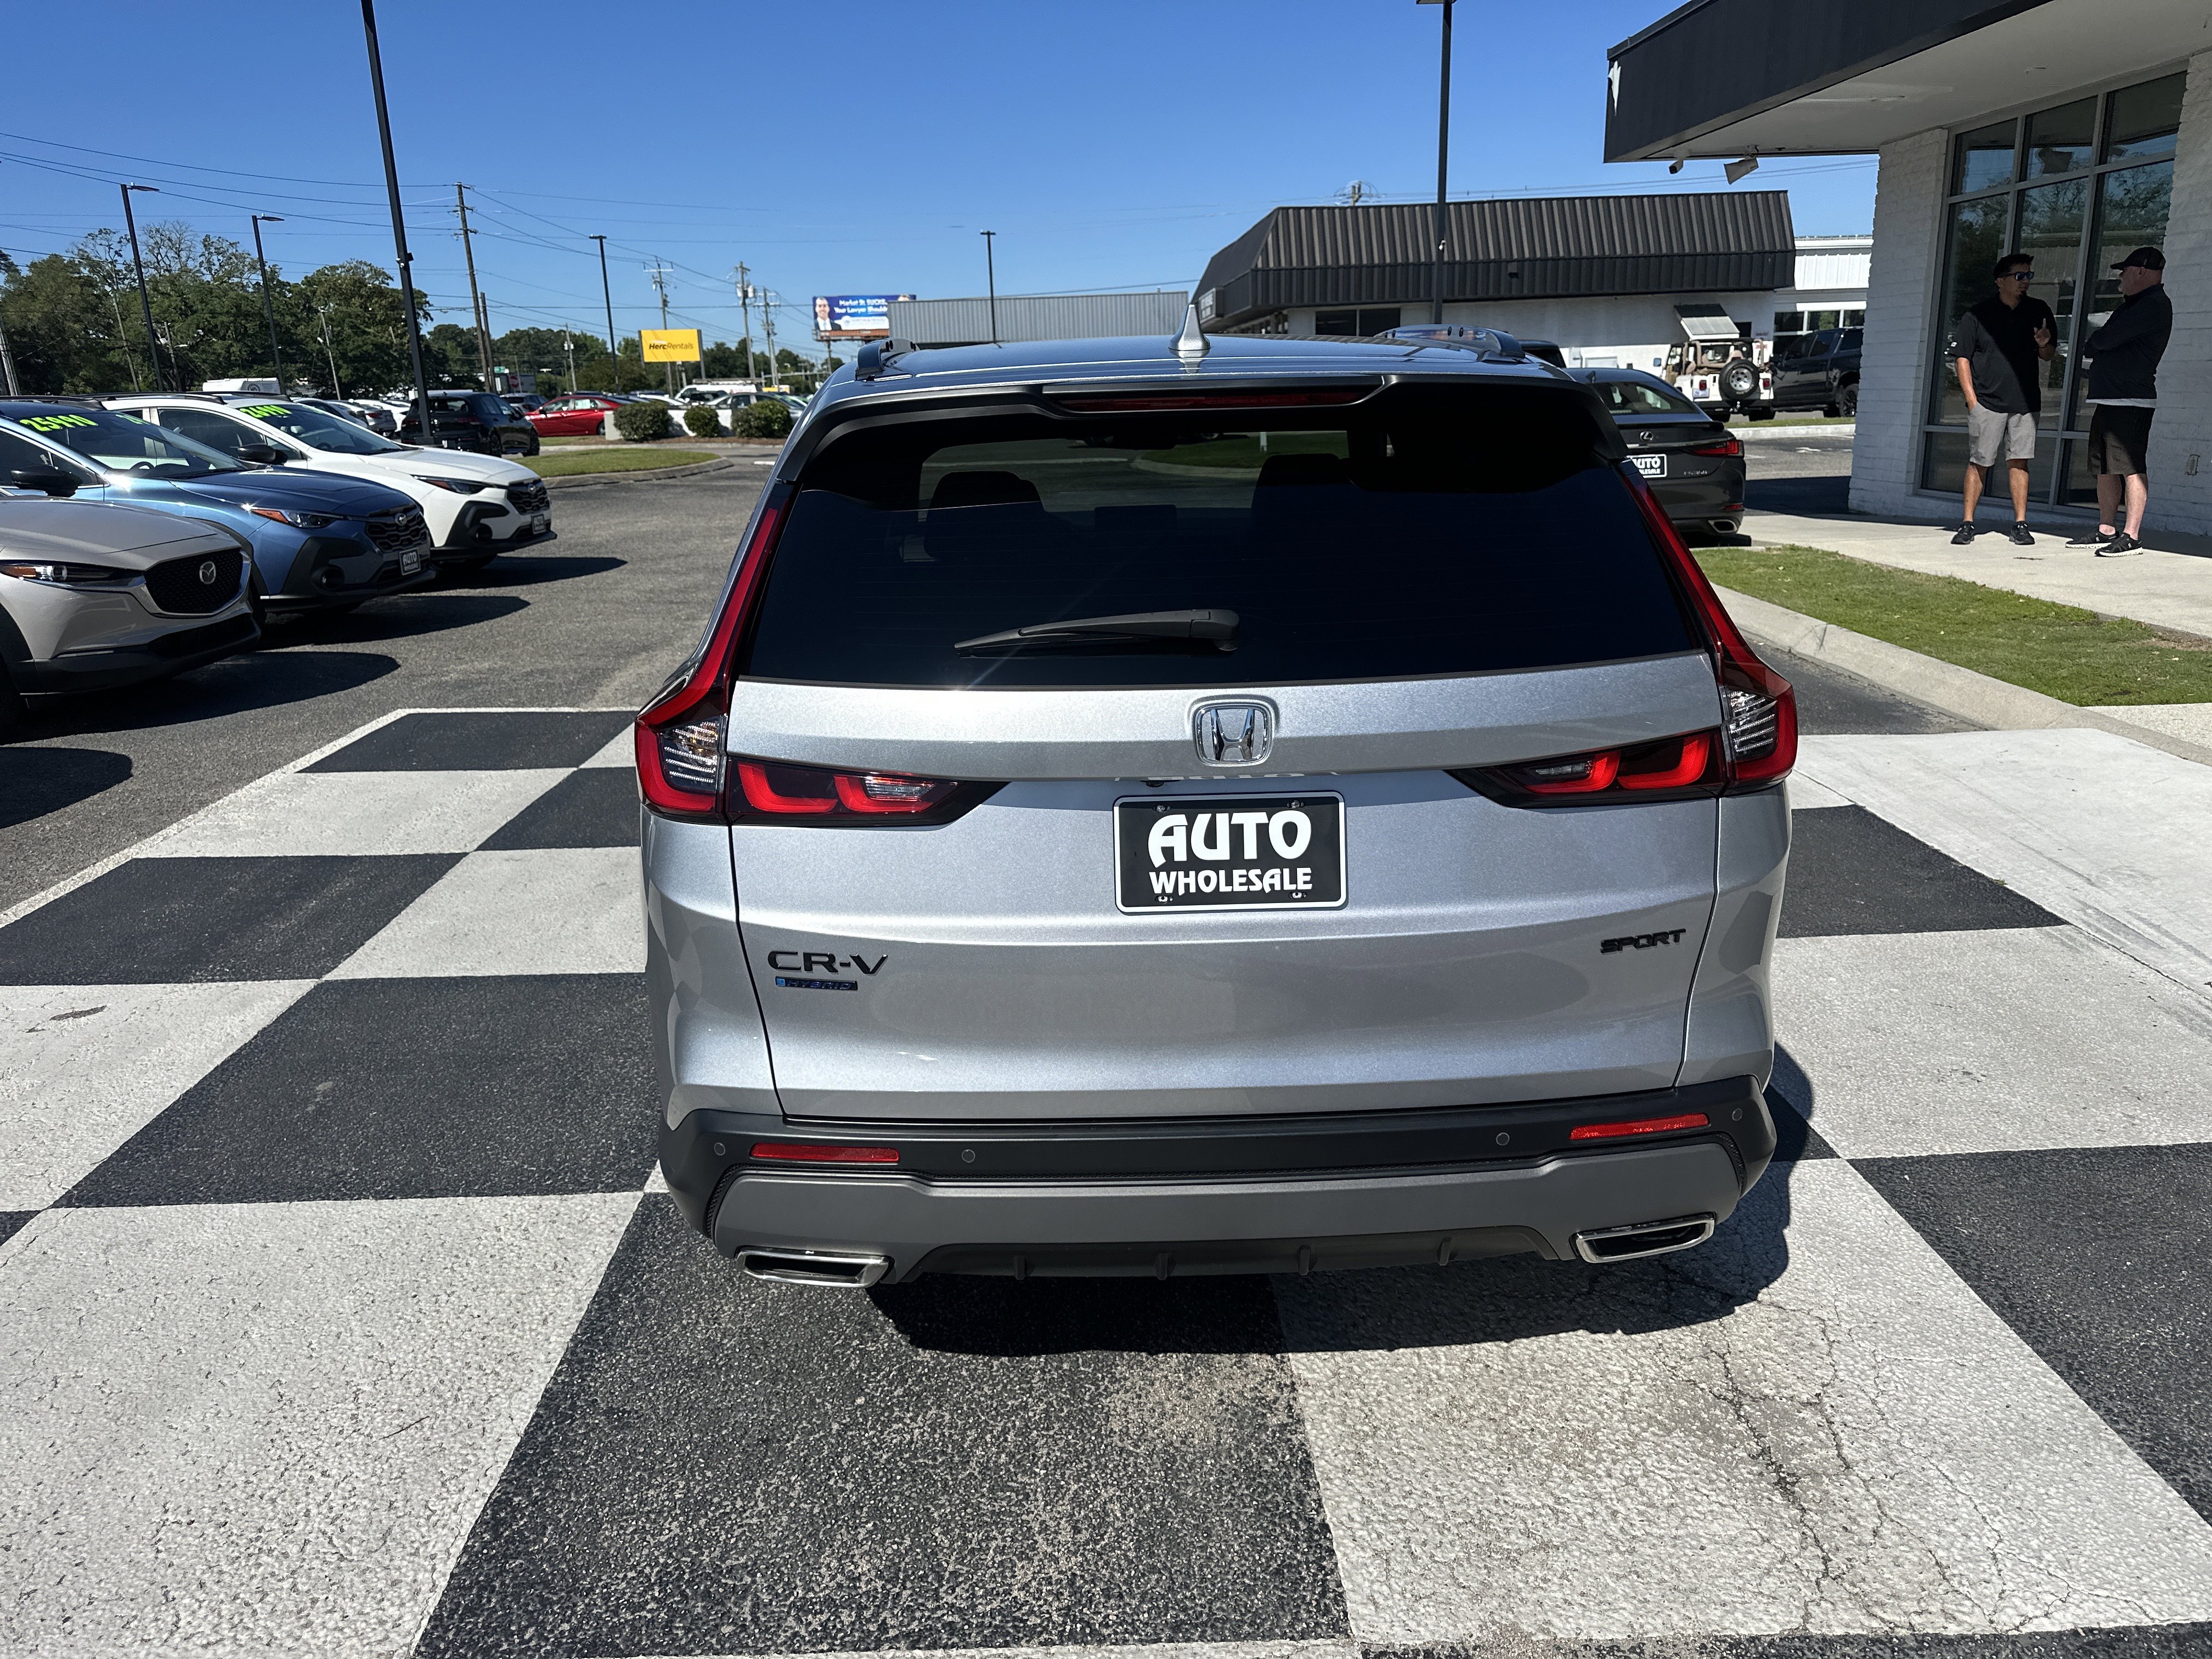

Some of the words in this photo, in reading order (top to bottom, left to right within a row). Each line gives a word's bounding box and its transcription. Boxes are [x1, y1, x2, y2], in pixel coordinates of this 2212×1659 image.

[19, 414, 99, 431] 25990
[403, 551, 417, 566] AUTO
[1148, 810, 1312, 868] AUTO
[1148, 867, 1313, 896] WHOLESALE
[1600, 928, 1686, 953] SPORT
[768, 950, 889, 975] CR-V
[786, 979, 853, 990] HYBRID
